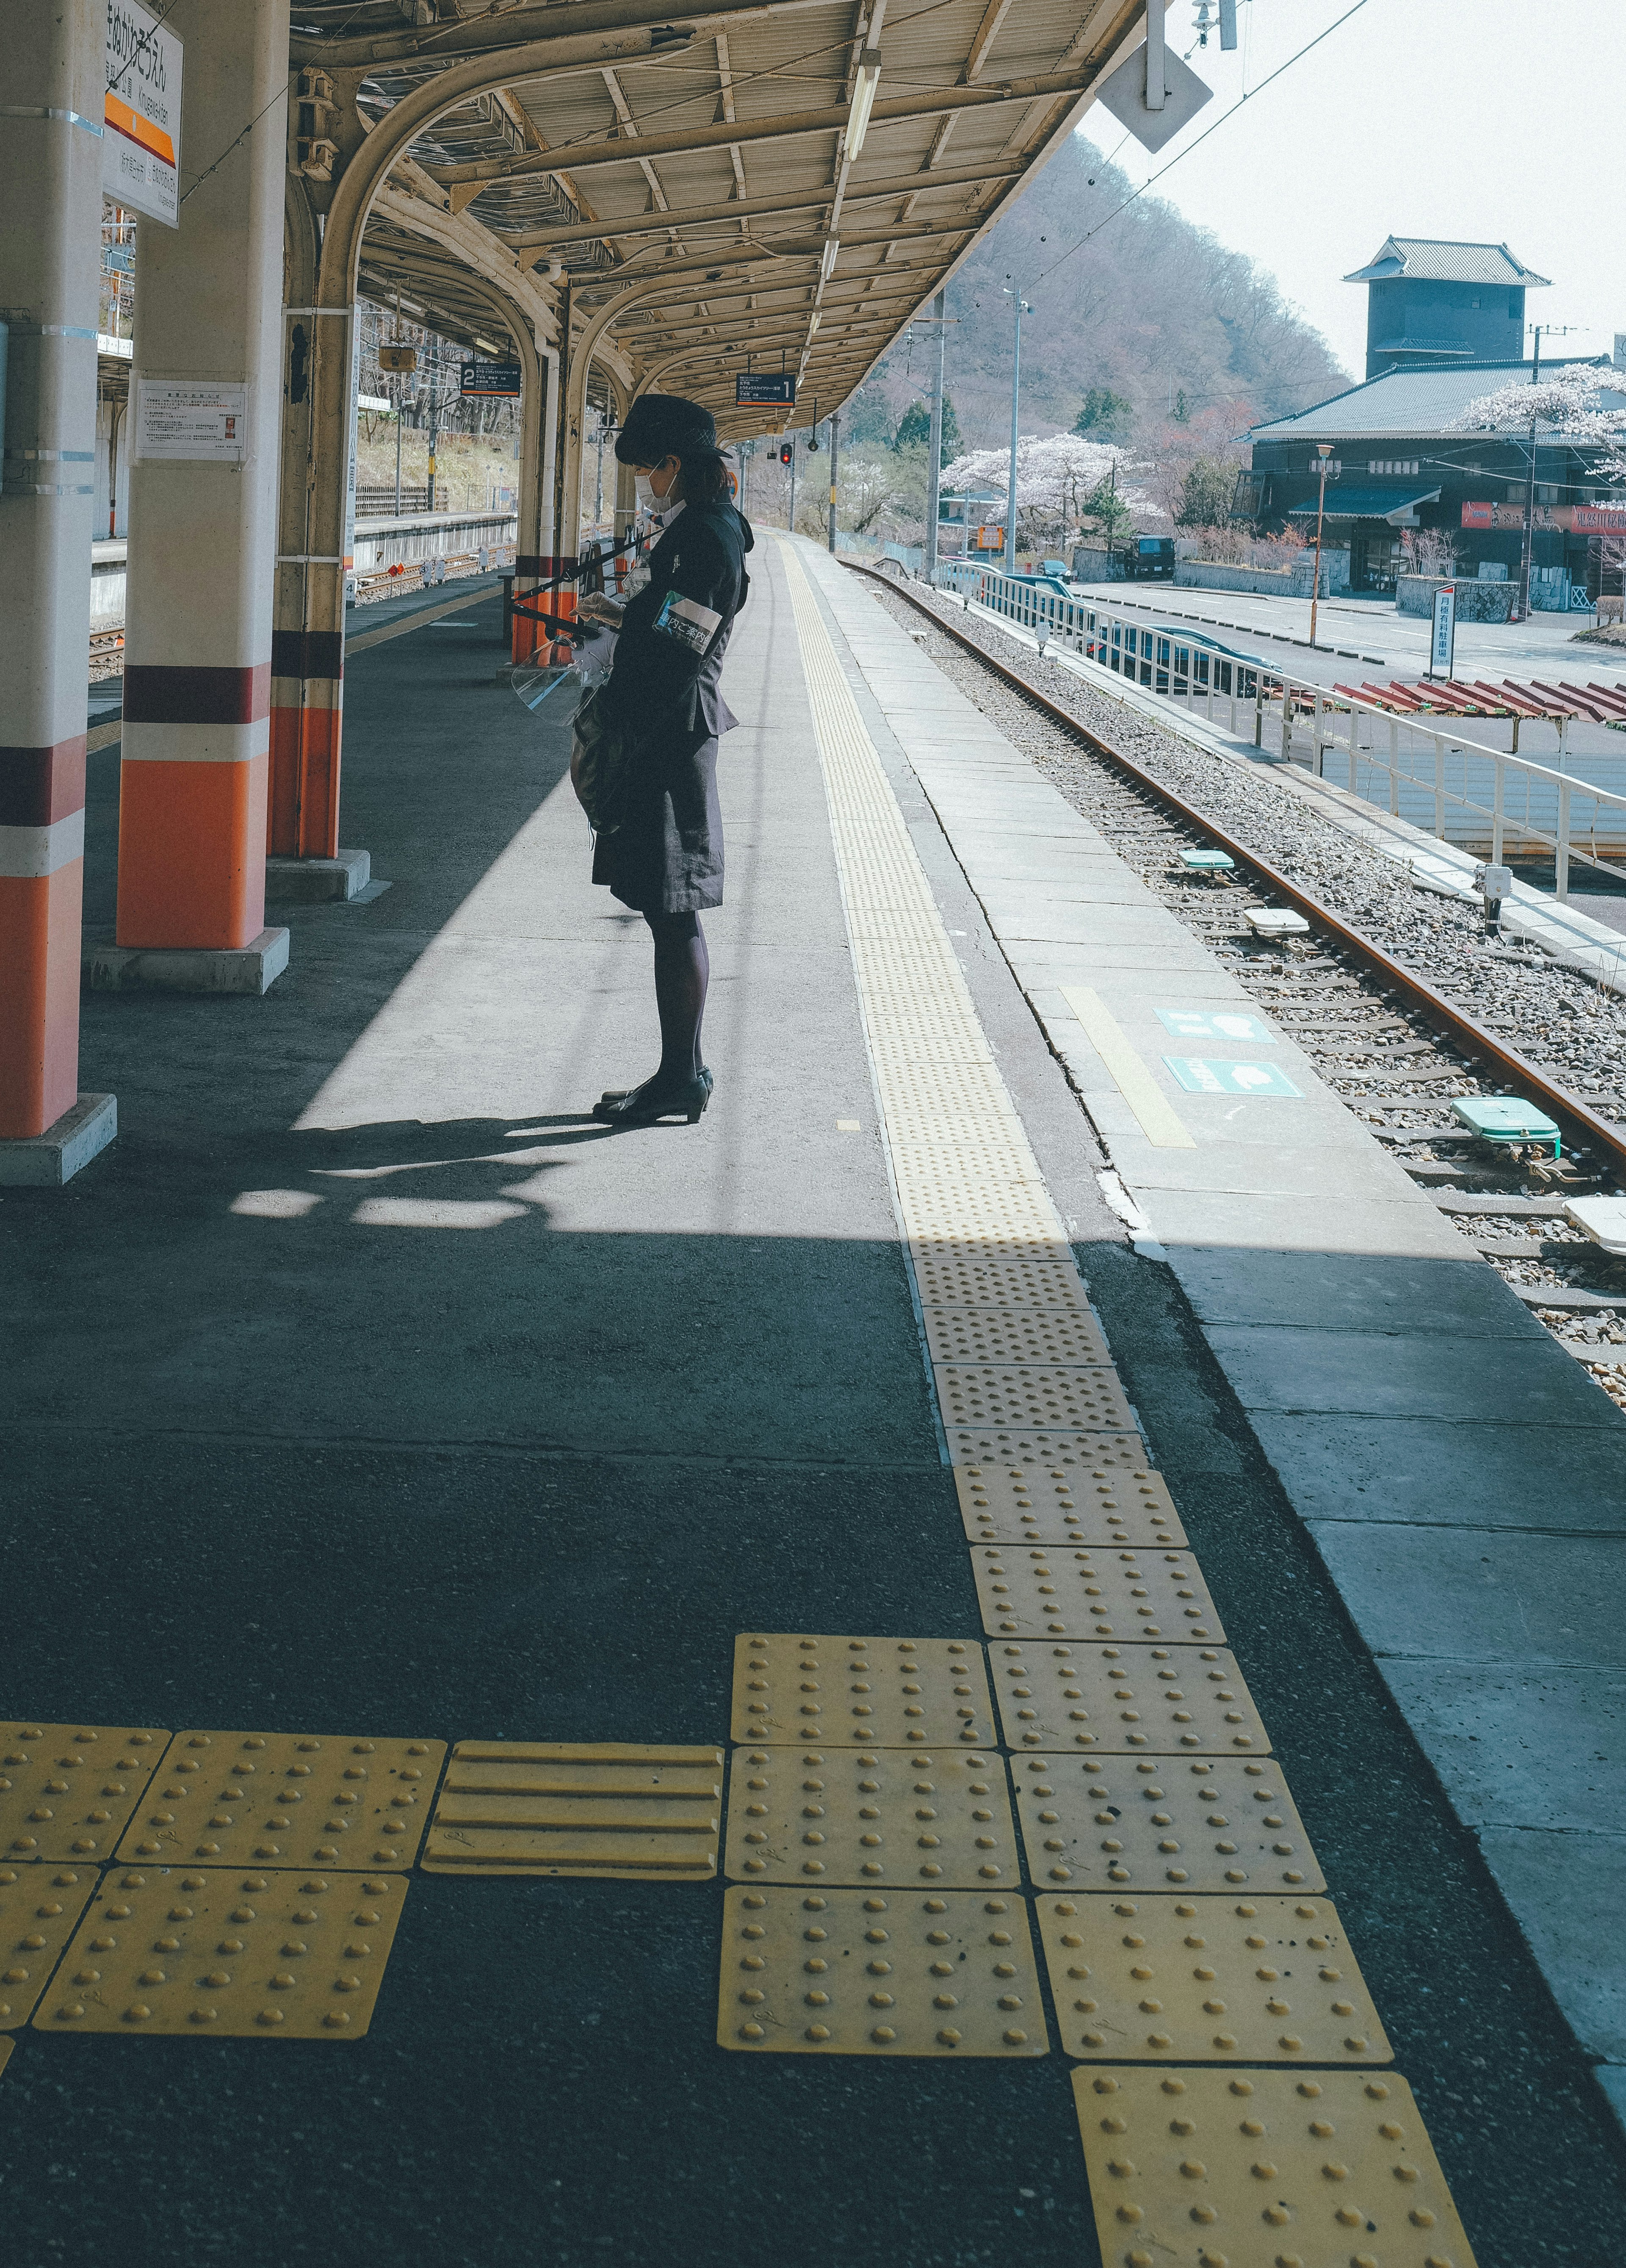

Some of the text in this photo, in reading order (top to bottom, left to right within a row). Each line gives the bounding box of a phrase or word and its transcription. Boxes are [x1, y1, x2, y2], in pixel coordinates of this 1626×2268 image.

[138, 85, 168, 126] Kinugawa-kōen
[464, 369, 475, 385] 2
[783, 381, 789, 398] 1
[348, 353, 358, 492] 鬼怒川公園
[346, 584, 353, 592] 4
[1438, 597, 1449, 658] 月極有料駐車場
